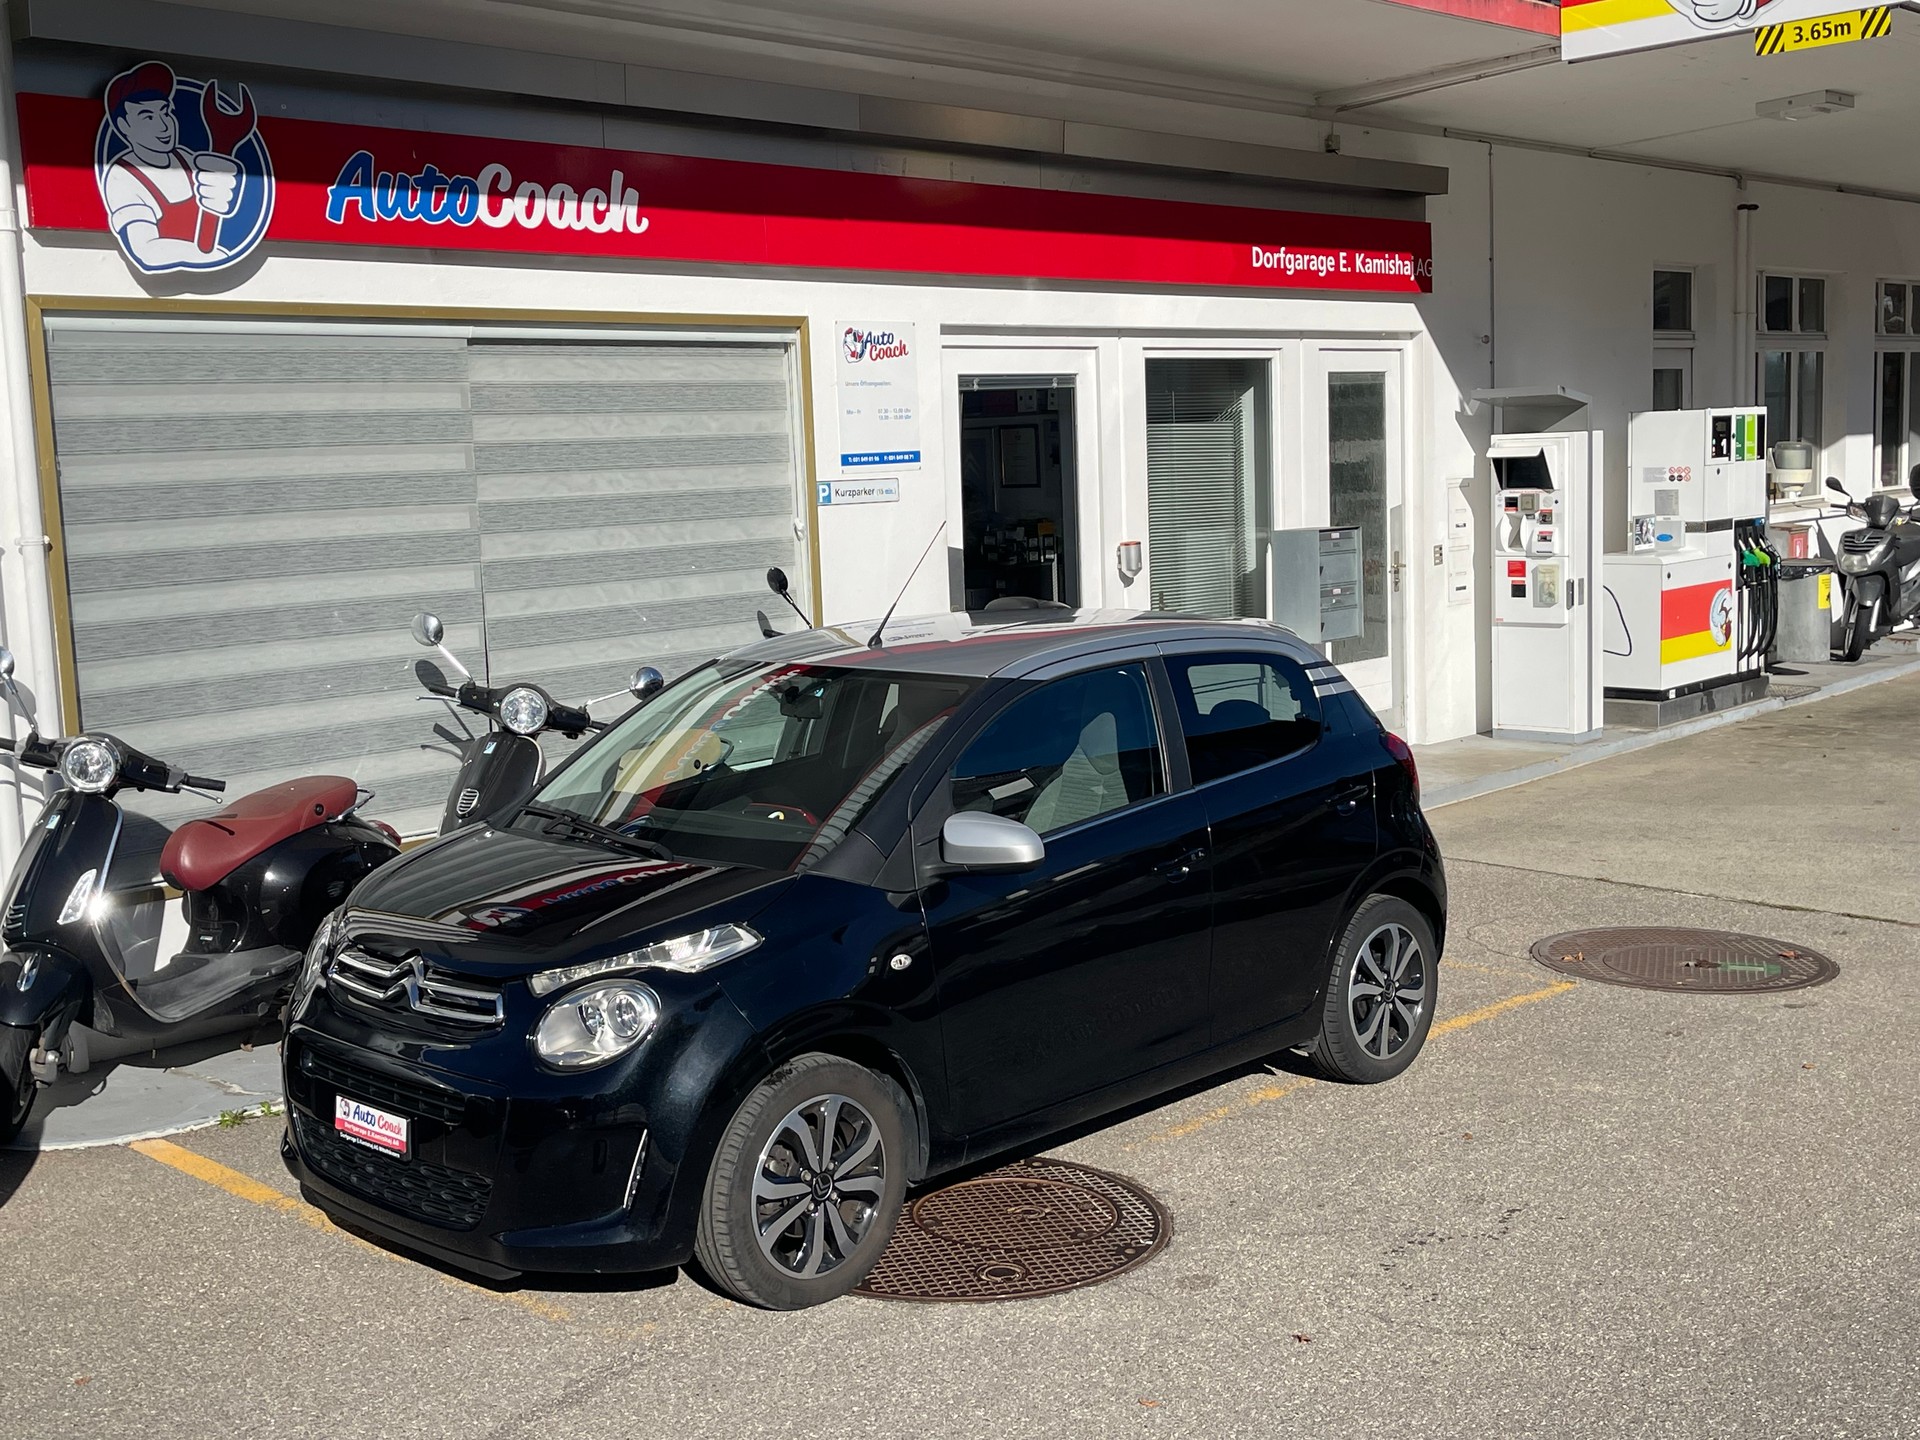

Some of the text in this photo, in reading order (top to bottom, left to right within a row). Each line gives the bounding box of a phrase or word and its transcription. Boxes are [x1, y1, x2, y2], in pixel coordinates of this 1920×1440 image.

[1793, 21, 1851, 43] 3.65m
[1252, 246, 1433, 281] Dorfgarage E. Kamishaj AG
[864, 331, 895, 350] Auto
[869, 339, 909, 361] Coach
[835, 487, 875, 498] Kurzparker
[353, 1104, 376, 1127] Auto
